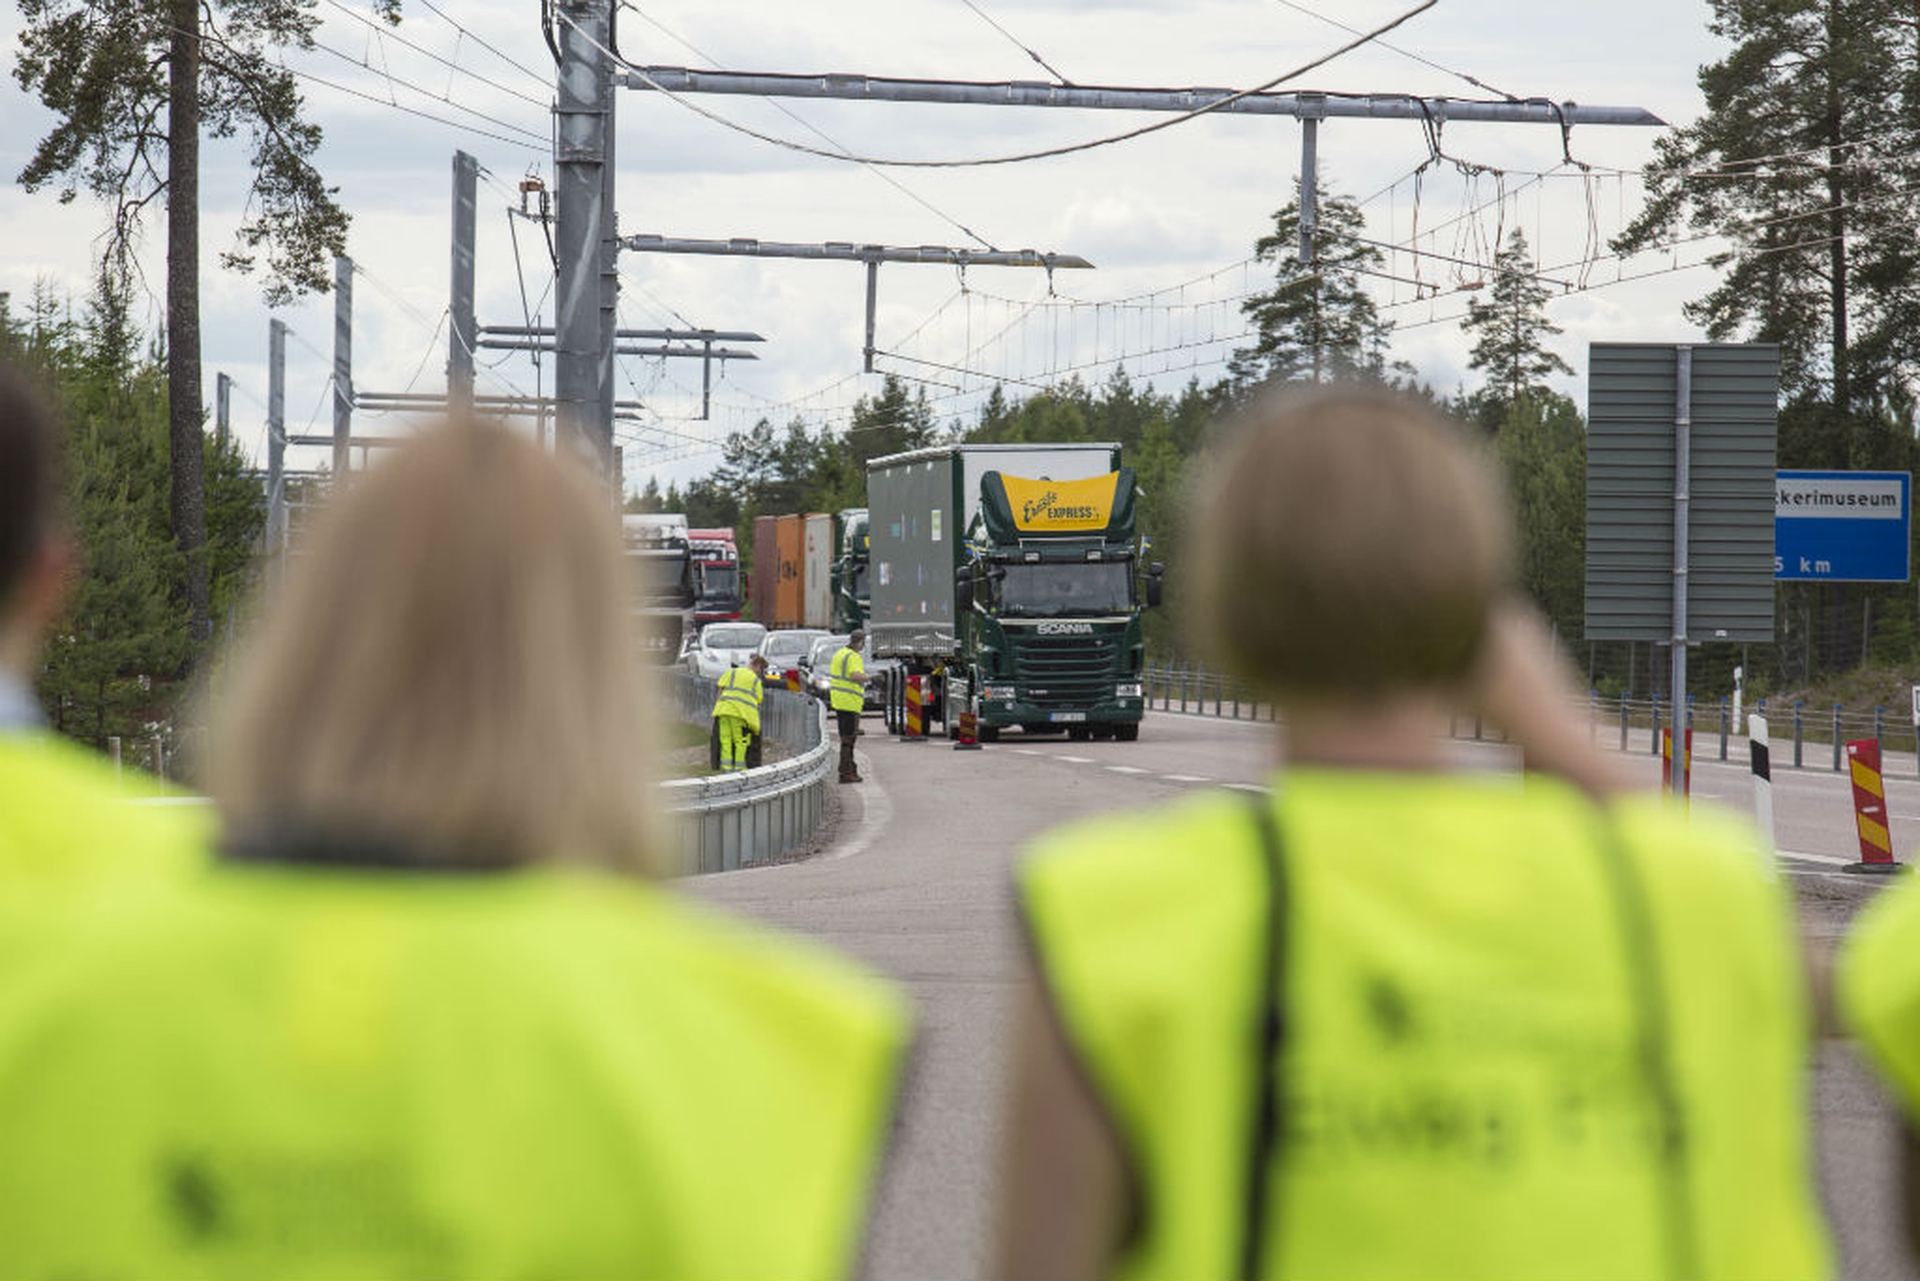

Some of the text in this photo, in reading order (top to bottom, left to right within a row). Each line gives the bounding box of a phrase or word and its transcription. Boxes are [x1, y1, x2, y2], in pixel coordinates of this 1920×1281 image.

[1047, 506, 1092, 519] EXPRESS
[1800, 557, 1831, 573] km
[1036, 623, 1094, 635] SCANIA
